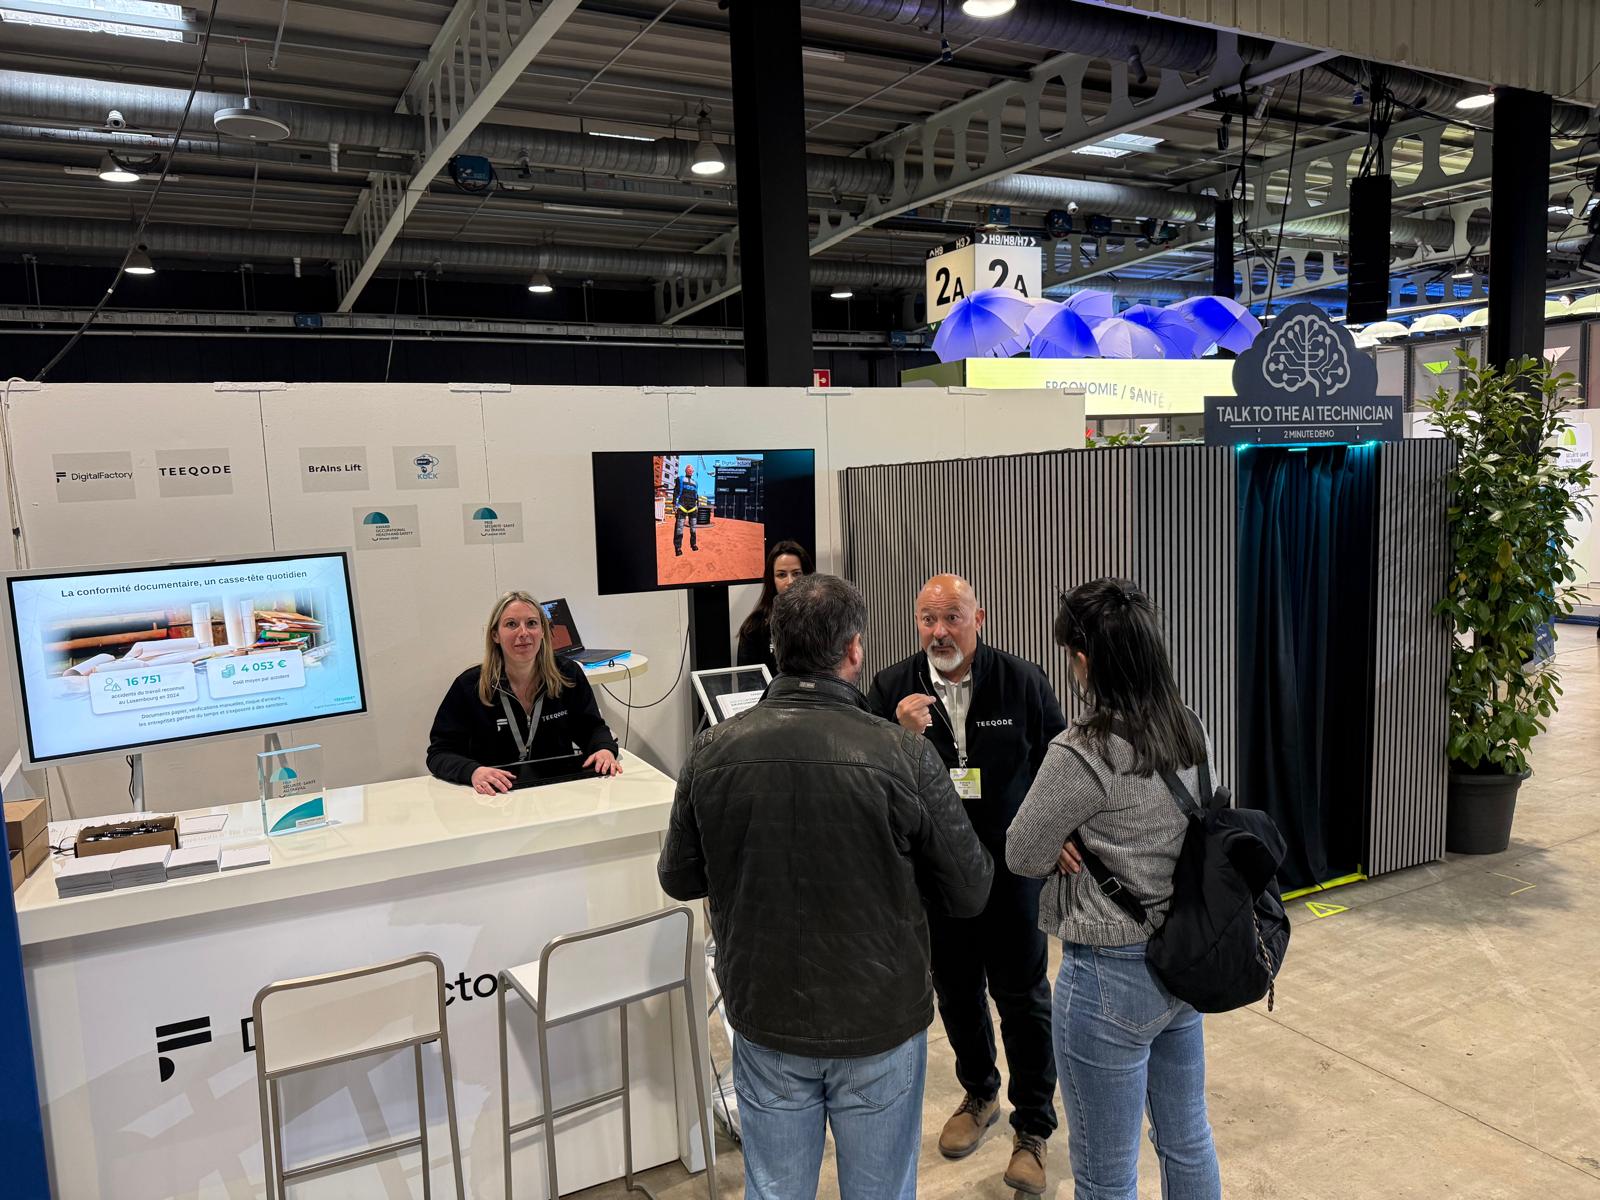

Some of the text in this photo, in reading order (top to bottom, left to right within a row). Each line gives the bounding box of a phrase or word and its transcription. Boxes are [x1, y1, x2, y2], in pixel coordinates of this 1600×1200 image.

[956, 236, 966, 249] H3
[989, 234, 1028, 246] H9/H8/H7
[936, 267, 965, 306] 2A
[1217, 405, 1393, 422] TALK TO THE AI TECHNICIAN
[1289, 430, 1315, 438] MINUTE
[1315, 430, 1334, 438] DEMO
[159, 465, 231, 476] TEEQODE
[308, 464, 362, 473] BrAIns Lift
[71, 471, 133, 482] DigitalFactory
[77, 585, 131, 596] conformité
[134, 580, 202, 592] documentaire,
[218, 574, 264, 584] casse-tête
[266, 571, 307, 581] quotidien
[241, 660, 287, 672] 4 053 €
[126, 674, 161, 686] 16 751
[542, 710, 568, 722] TEEQODE
[976, 719, 1013, 727] TEEQODE
